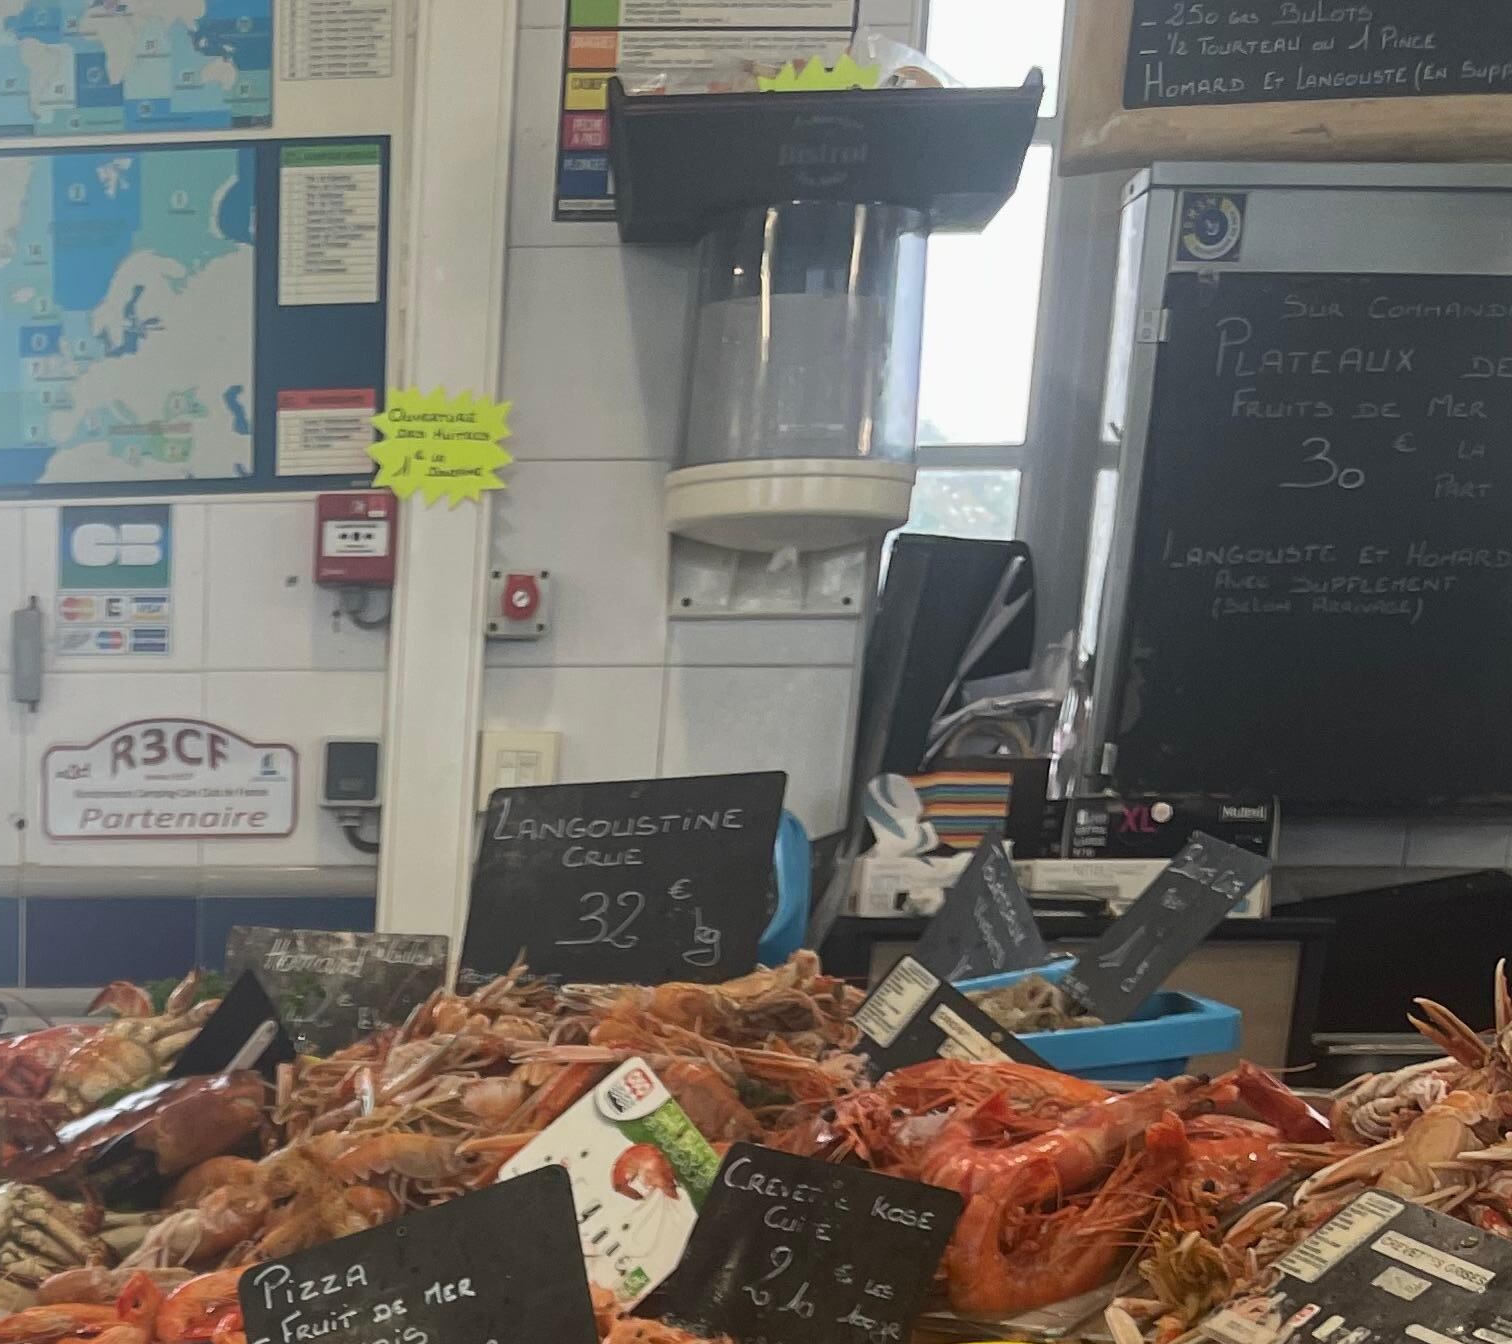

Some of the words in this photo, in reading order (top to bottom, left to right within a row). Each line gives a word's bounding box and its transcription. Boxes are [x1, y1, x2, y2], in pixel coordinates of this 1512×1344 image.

[1165, 3, 1218, 27] 250
[1197, 28, 1301, 56] TOURTEAU
[1348, 25, 1370, 51] 1
[1381, 26, 1438, 50] PINCE
[1143, 61, 1246, 101] HOMARD
[1296, 63, 1408, 90] LANGOUSTE
[1215, 316, 1416, 377] PLATEAUX
[1231, 388, 1335, 419] FRUITS
[1351, 402, 1402, 419] DE
[1425, 393, 1488, 420] MER
[1277, 437, 1367, 490] 30
[1392, 431, 1418, 453] €
[1457, 439, 1486, 461] LA
[1433, 473, 1493, 499] PART
[1161, 528, 1338, 568] LANGOUSTE
[1405, 541, 1512, 568] HOMARD
[1288, 576, 1458, 594] SUPPLEMENT
[108, 727, 232, 778] R3CF
[78, 806, 270, 830] Partenaire
[491, 797, 746, 842] LANGOUSTINE
[561, 846, 645, 868] CRUE
[554, 890, 647, 950] 32
[666, 878, 693, 900] €
[371, 1299, 408, 1324] DE
[423, 1277, 478, 1305] MER
